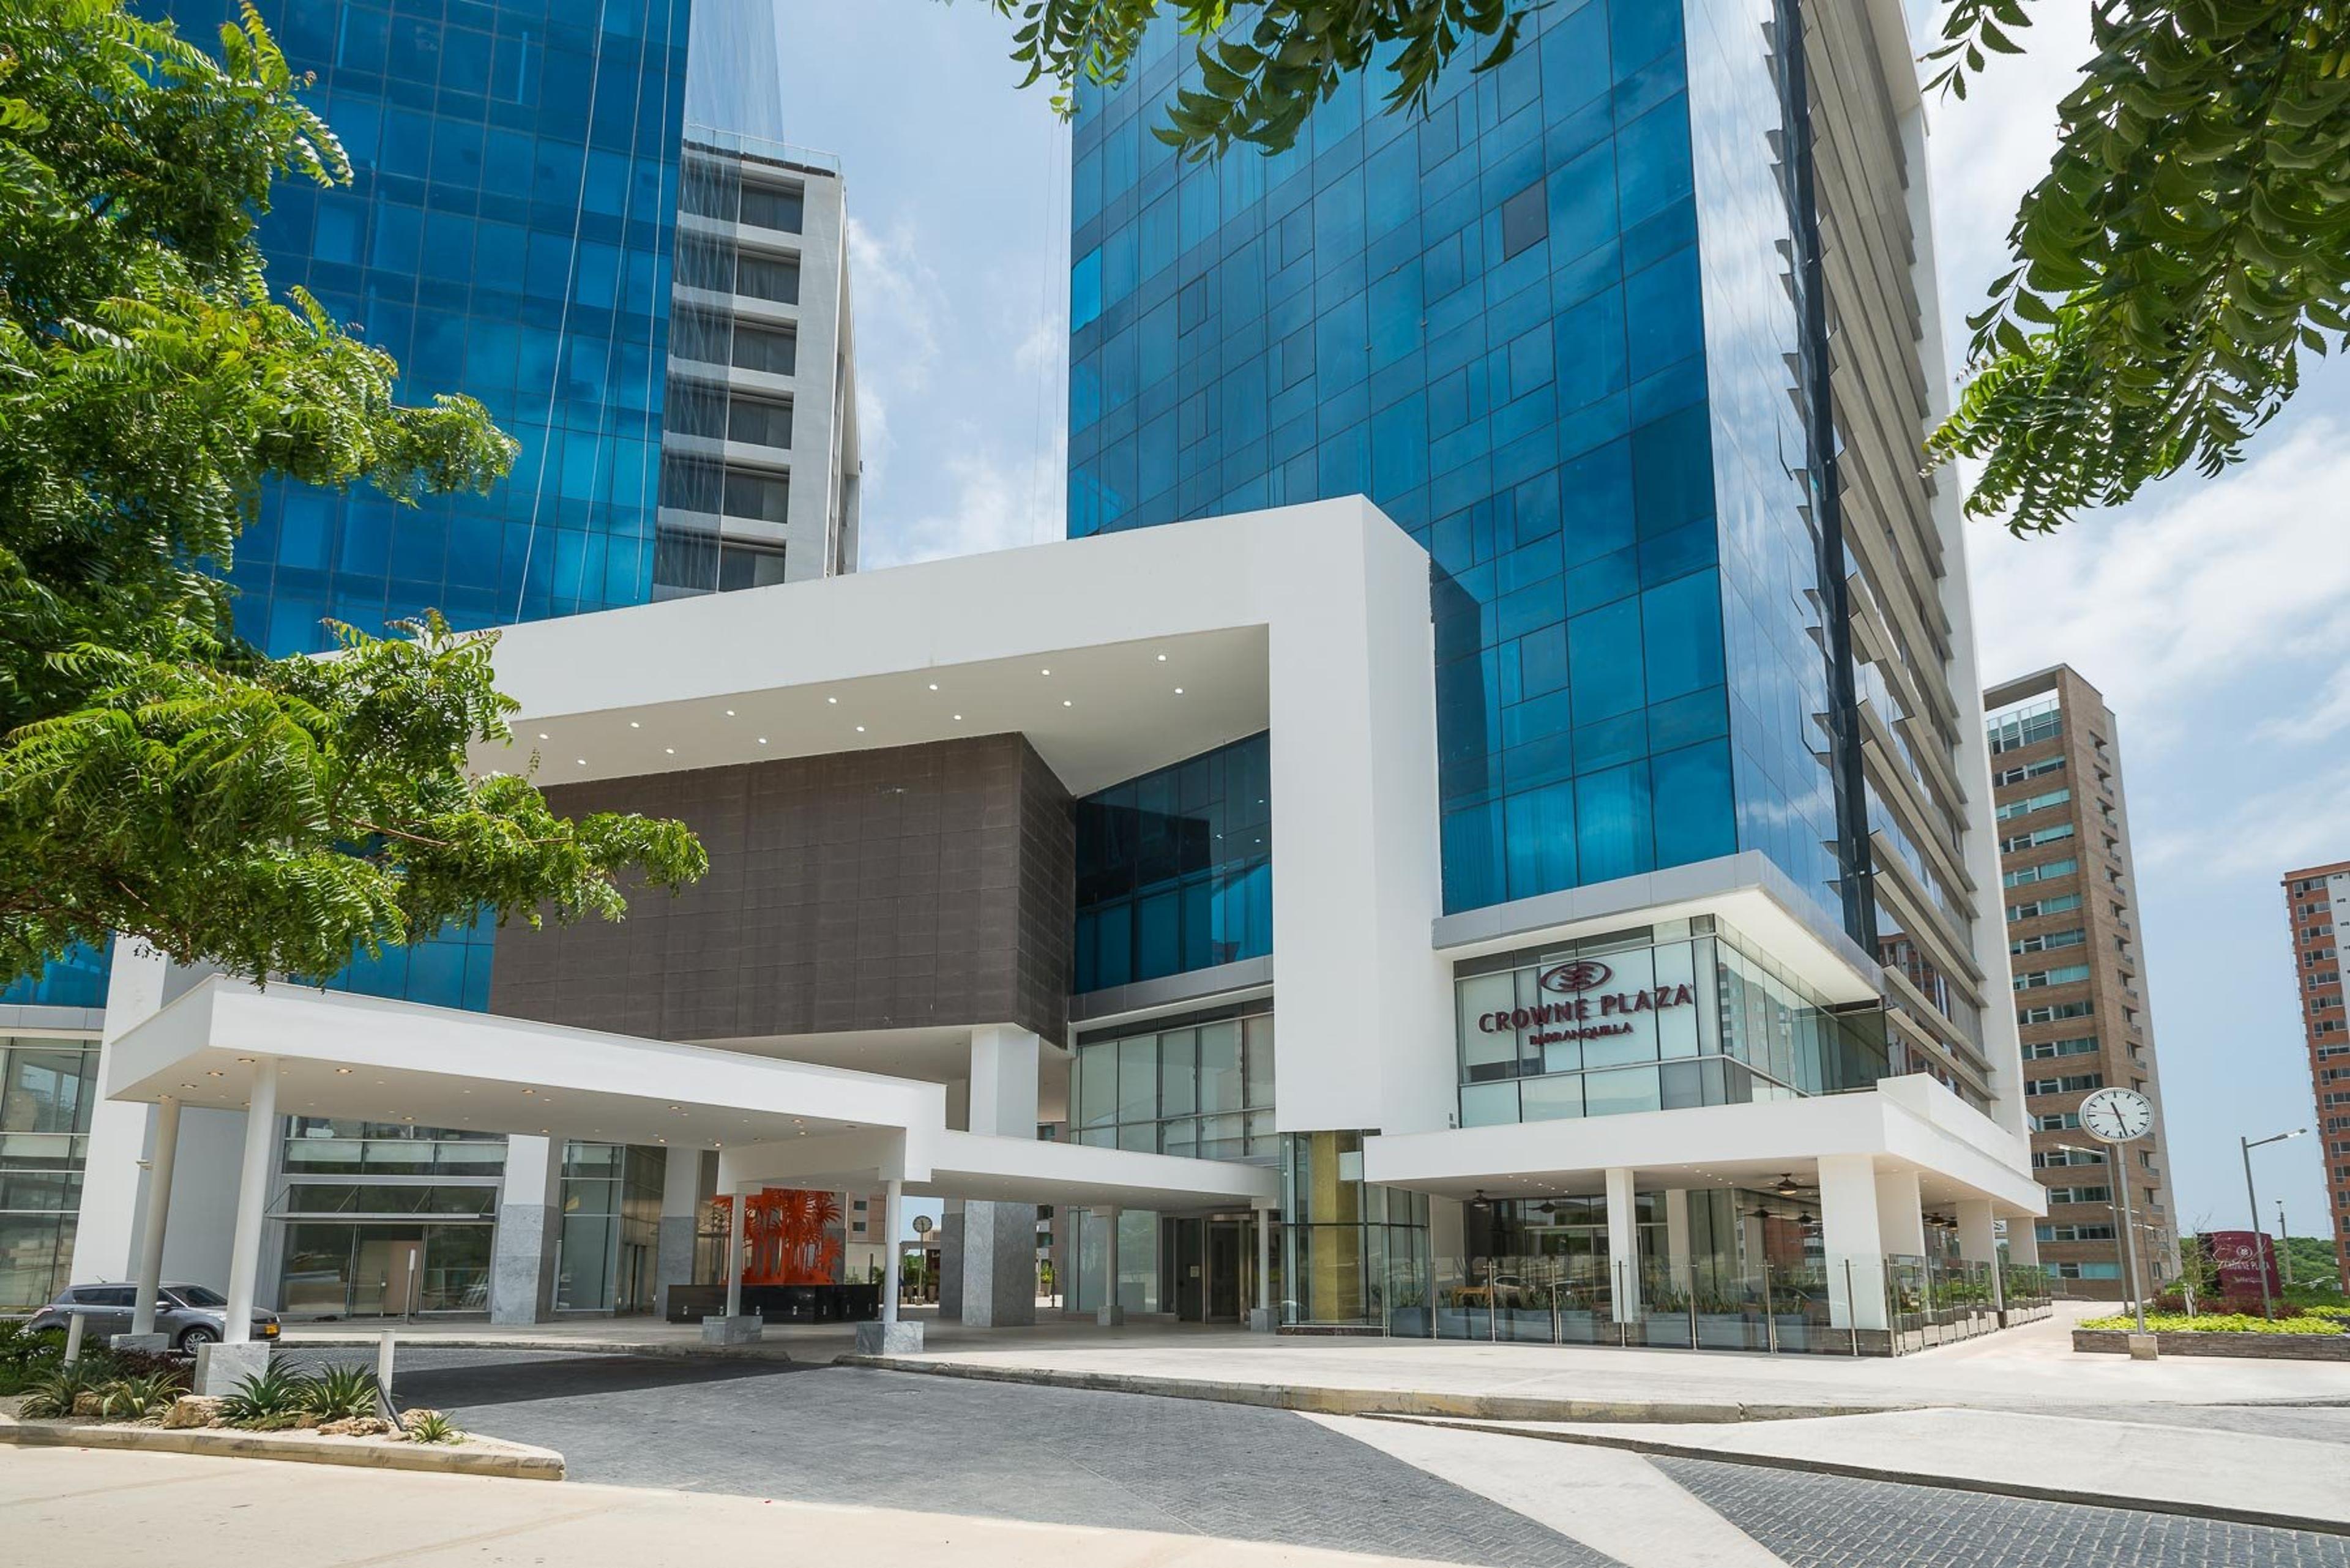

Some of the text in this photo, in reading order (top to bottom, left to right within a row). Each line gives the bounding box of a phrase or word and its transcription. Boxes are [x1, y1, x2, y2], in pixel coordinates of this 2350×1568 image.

[1479, 984, 1693, 1033] CROWNE PLAZA
[1529, 1021, 1633, 1045] BARRANQUILLA
